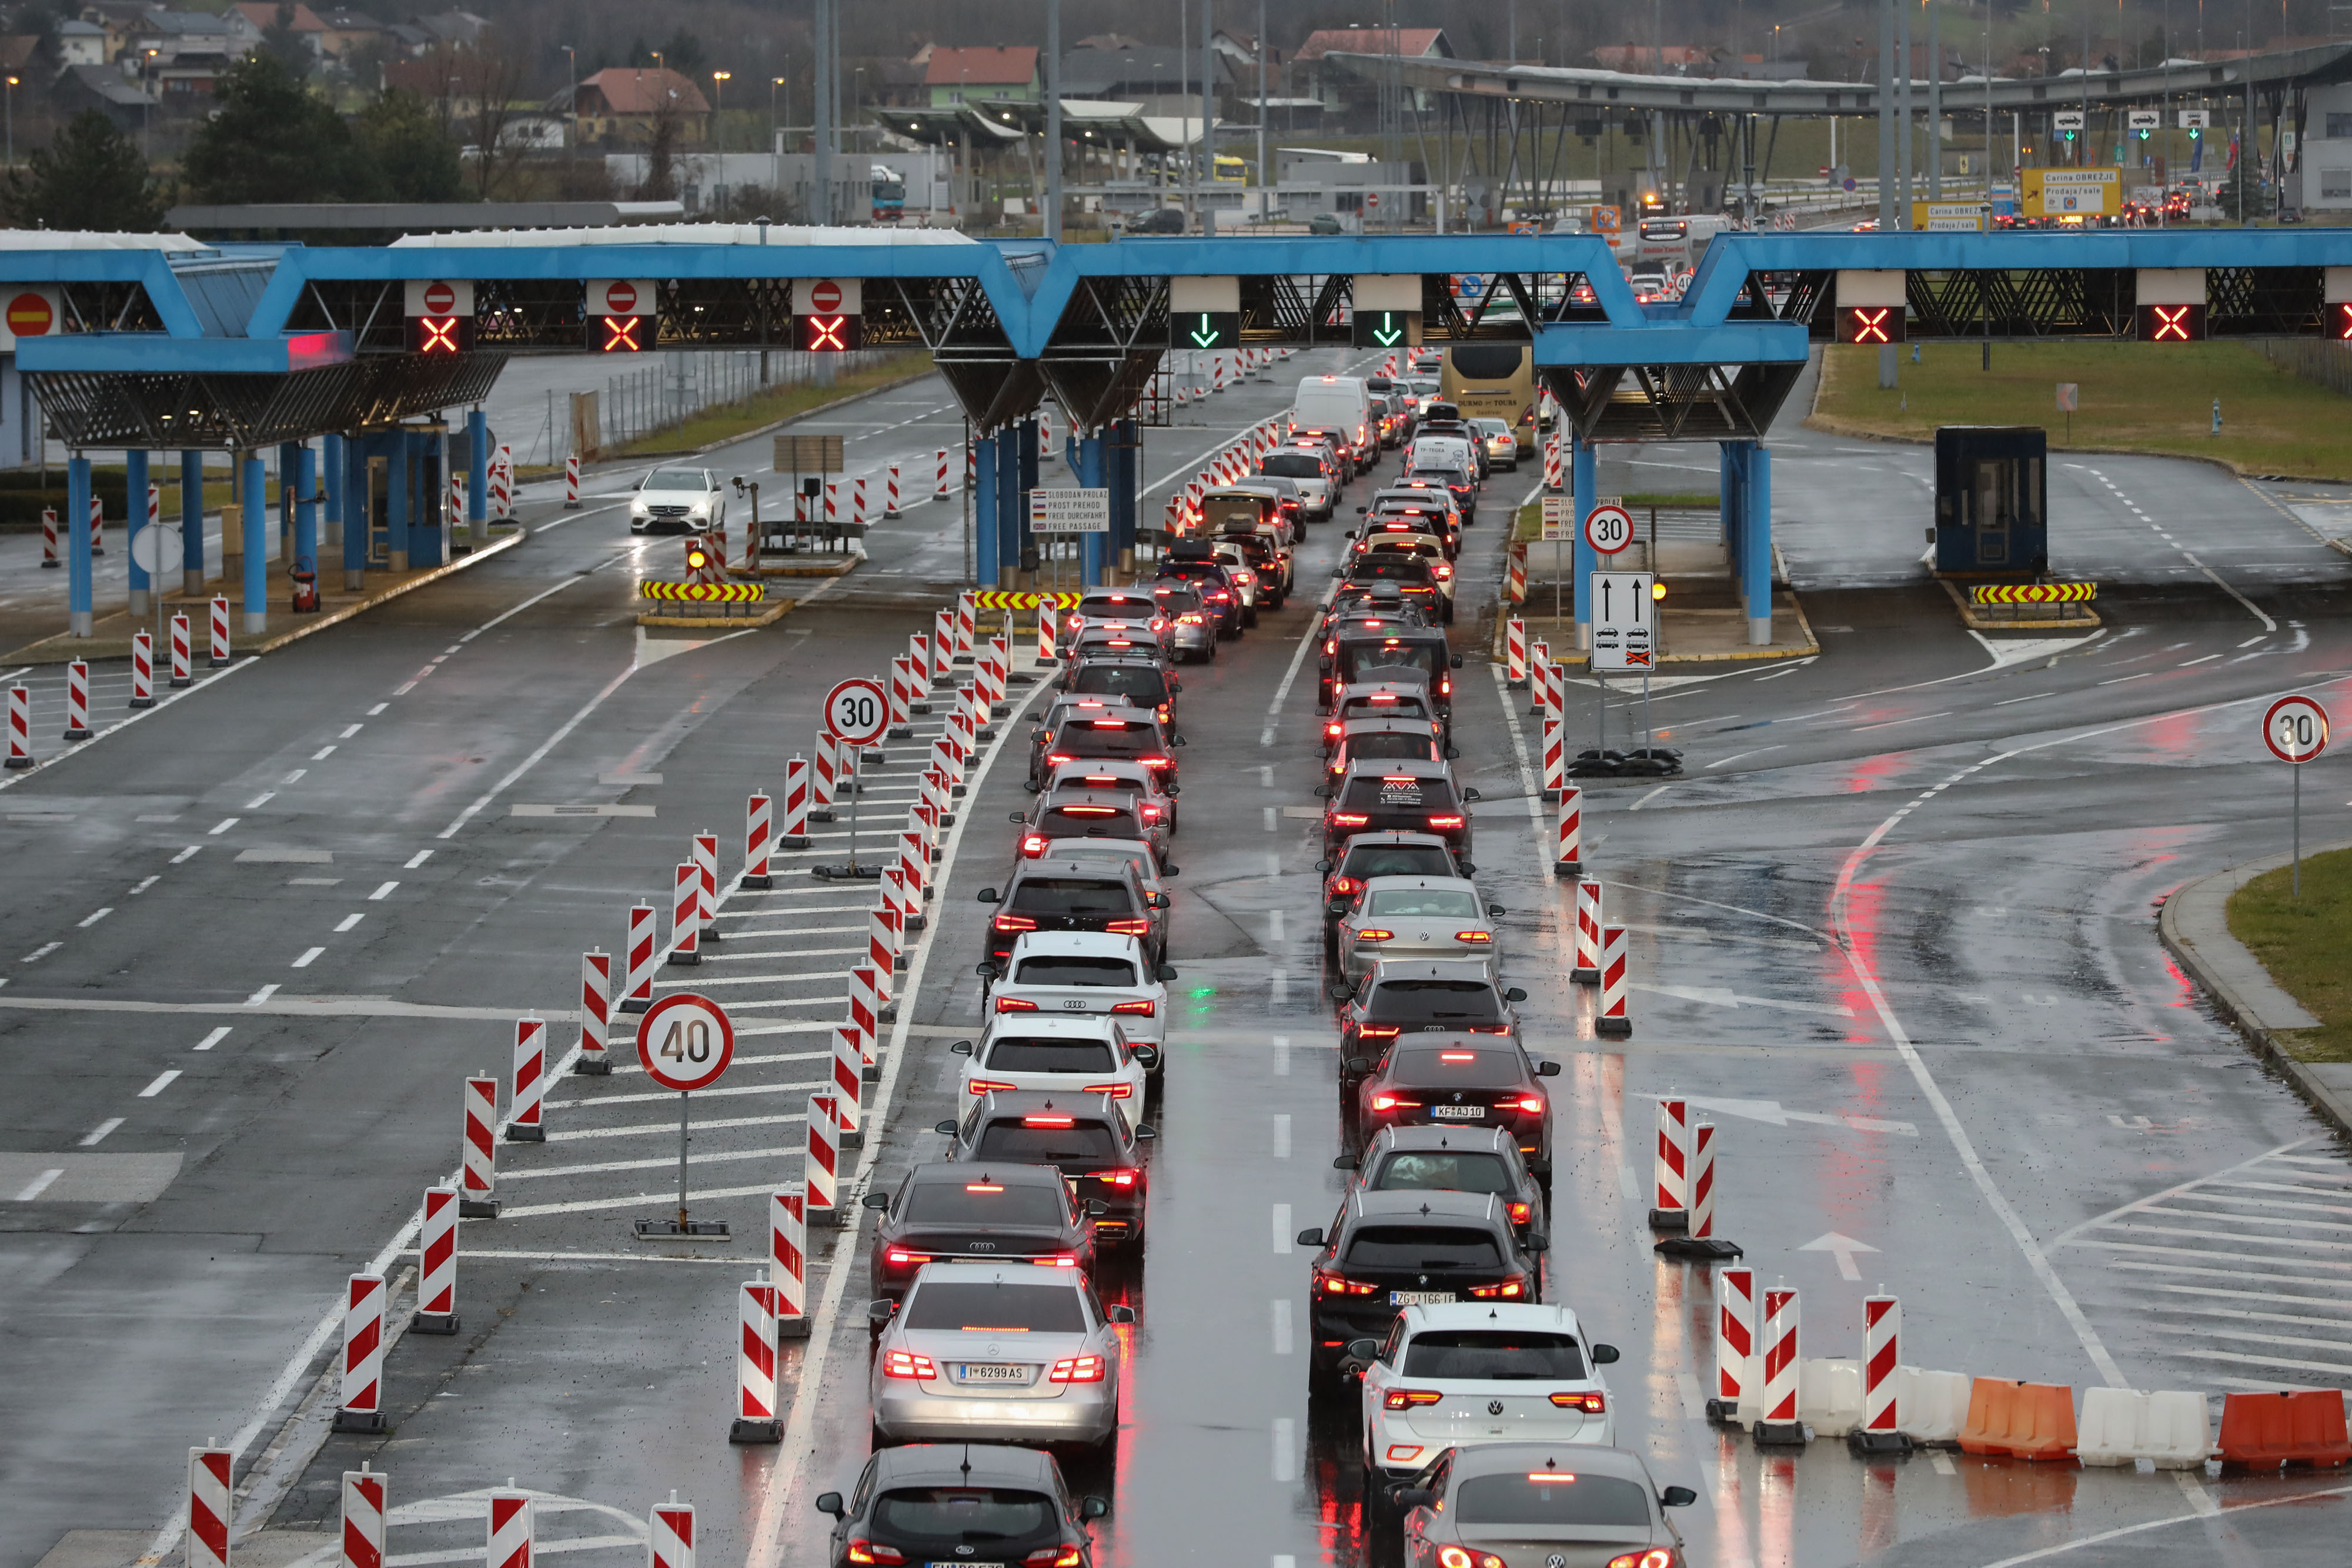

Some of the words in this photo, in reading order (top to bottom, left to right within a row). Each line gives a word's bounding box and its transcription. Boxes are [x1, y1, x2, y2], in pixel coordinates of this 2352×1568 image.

[2076, 173, 2114, 181] OBREŽJE
[1598, 519, 1622, 541] 30
[841, 697, 874, 727] 30
[2279, 714, 2313, 745] 30
[660, 1019, 710, 1062] 40
[1439, 1108, 1451, 1116] KF
[1398, 1293, 1410, 1304] ZG
